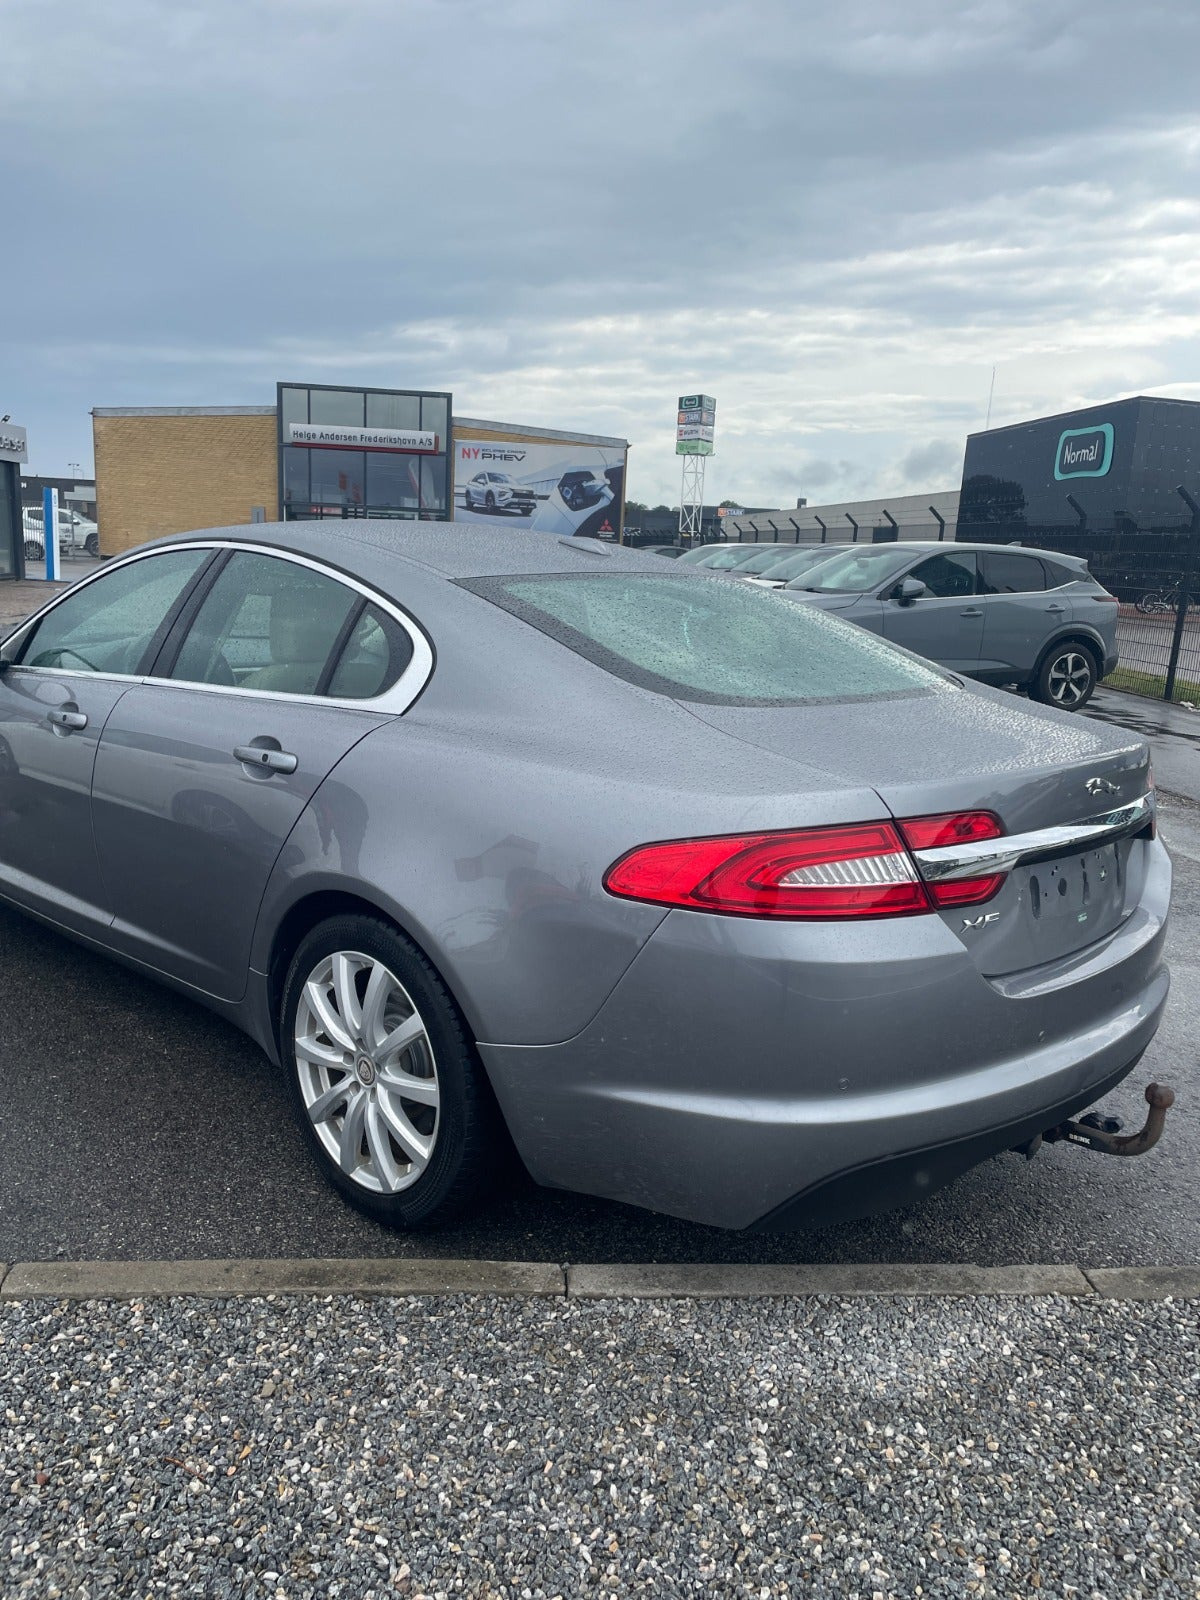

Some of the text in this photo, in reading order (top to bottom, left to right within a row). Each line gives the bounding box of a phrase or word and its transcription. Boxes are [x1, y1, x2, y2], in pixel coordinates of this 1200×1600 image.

[293, 430, 433, 447] Helge Andersen Frederikshavn A/S
[461, 447, 480, 459] NY
[481, 453, 526, 461] PHEV
[1063, 440, 1099, 465] Normal
[960, 911, 1001, 934] XF
